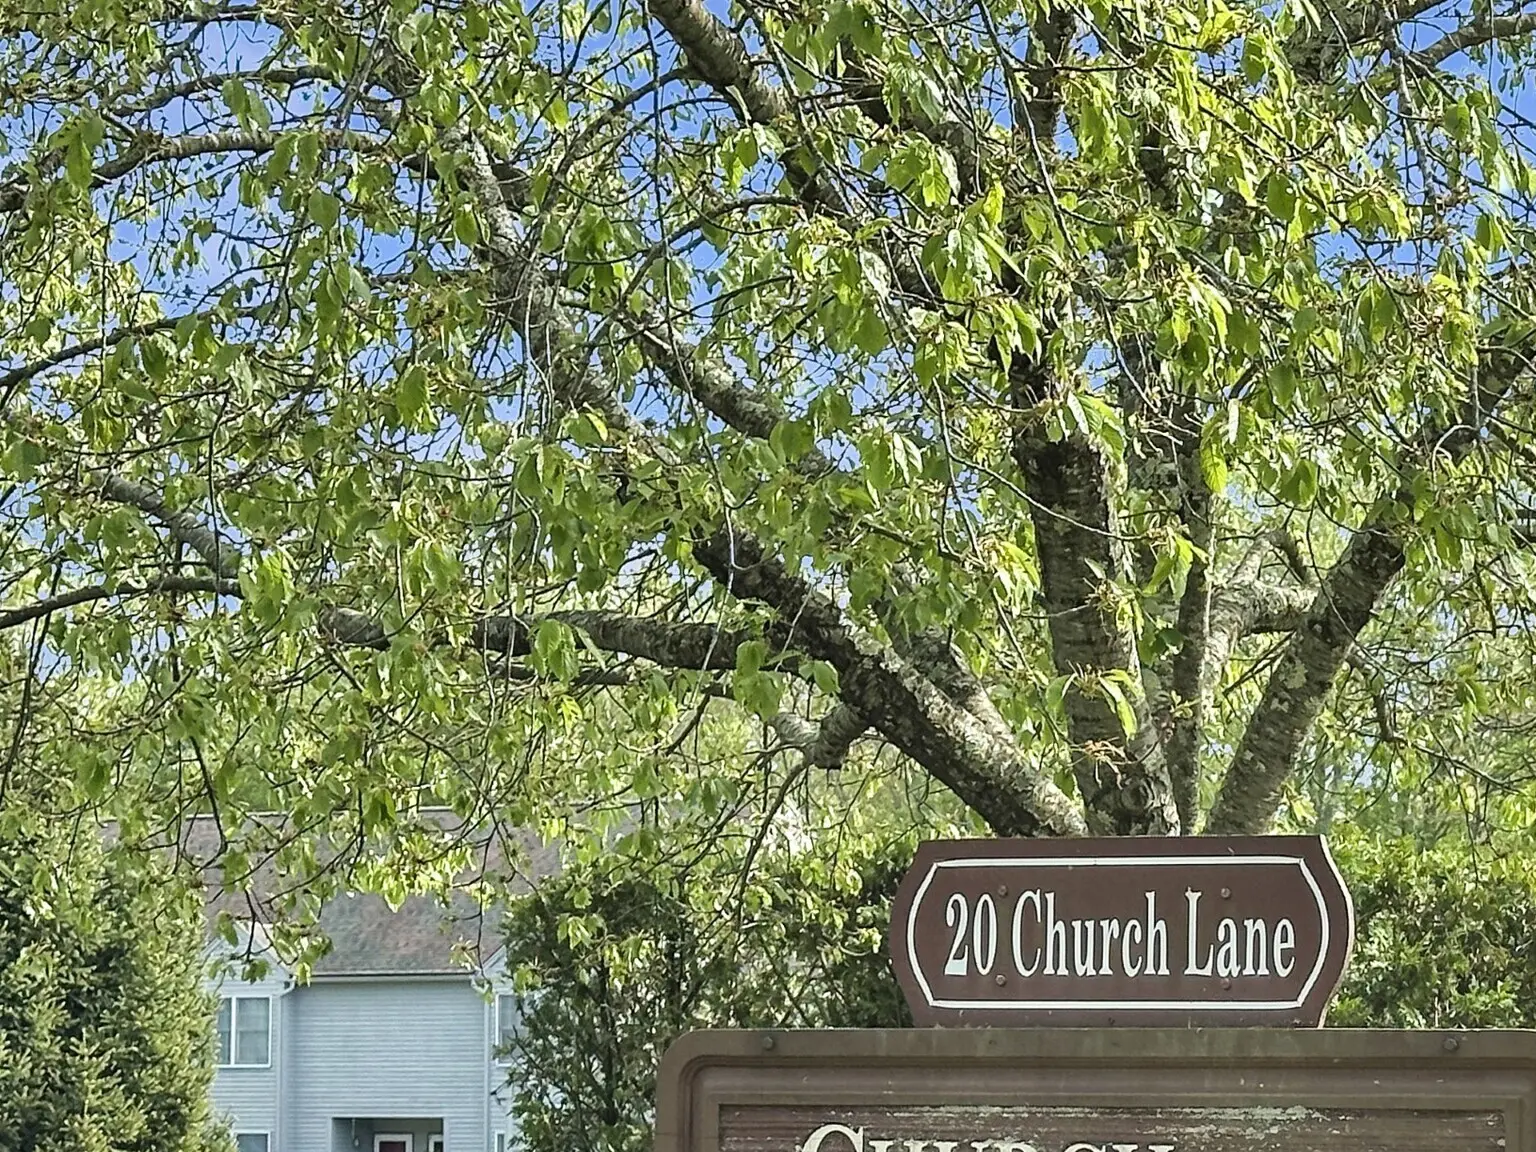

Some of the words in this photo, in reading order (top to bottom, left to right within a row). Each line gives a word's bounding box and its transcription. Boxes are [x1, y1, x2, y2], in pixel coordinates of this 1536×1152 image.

[944, 892, 998, 977] 20
[1011, 888, 1170, 977] Church
[1184, 888, 1296, 977] Lane
